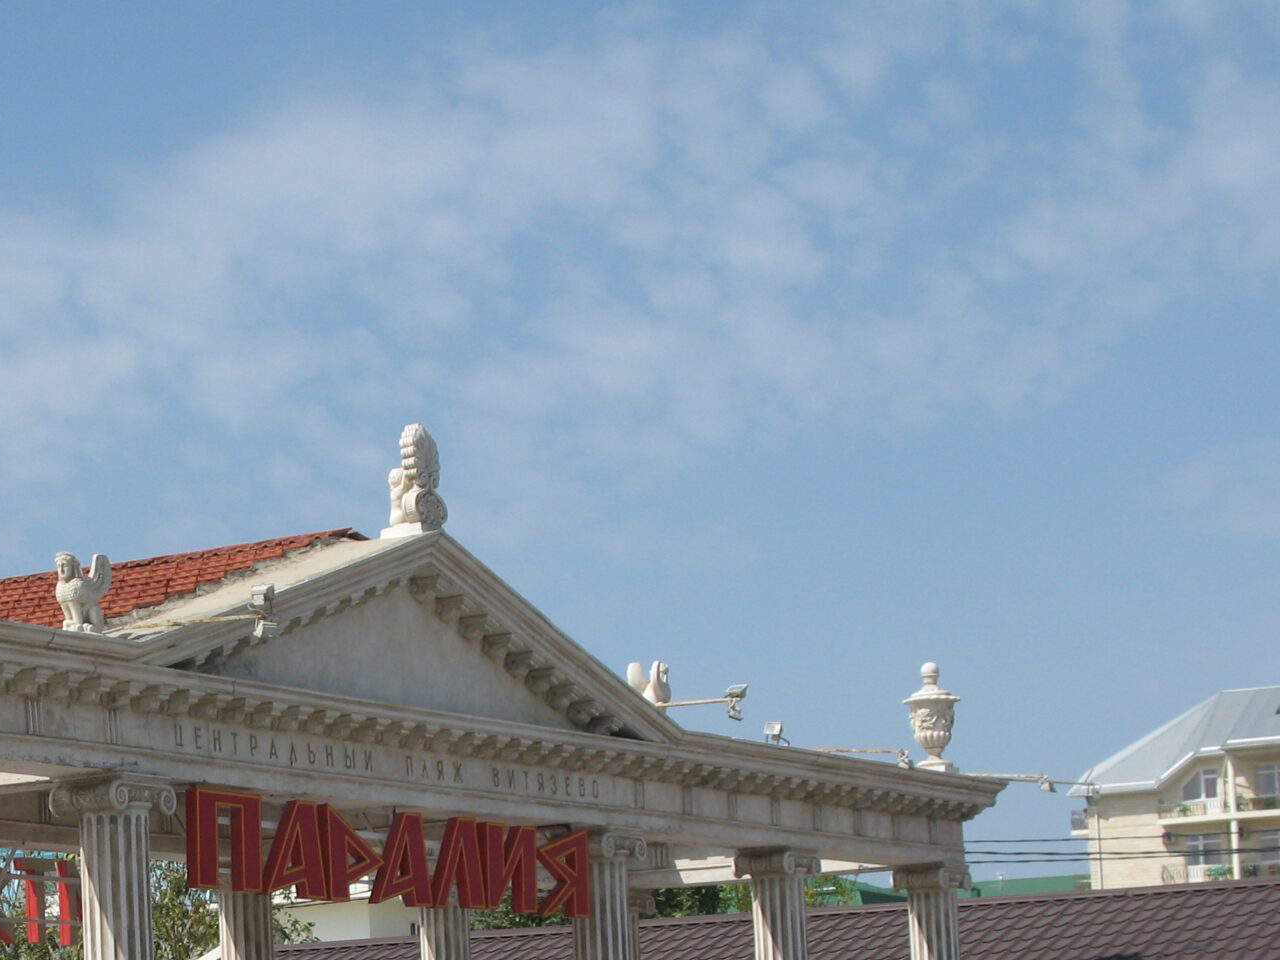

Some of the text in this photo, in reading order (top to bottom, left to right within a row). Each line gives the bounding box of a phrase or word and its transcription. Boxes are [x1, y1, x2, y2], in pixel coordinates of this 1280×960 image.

[405, 755, 464, 783] ПЛЯЖ
[492, 767, 601, 800] ВИТЯЗЕВО
[186, 787, 590, 918] ПАРАЛИЯ
